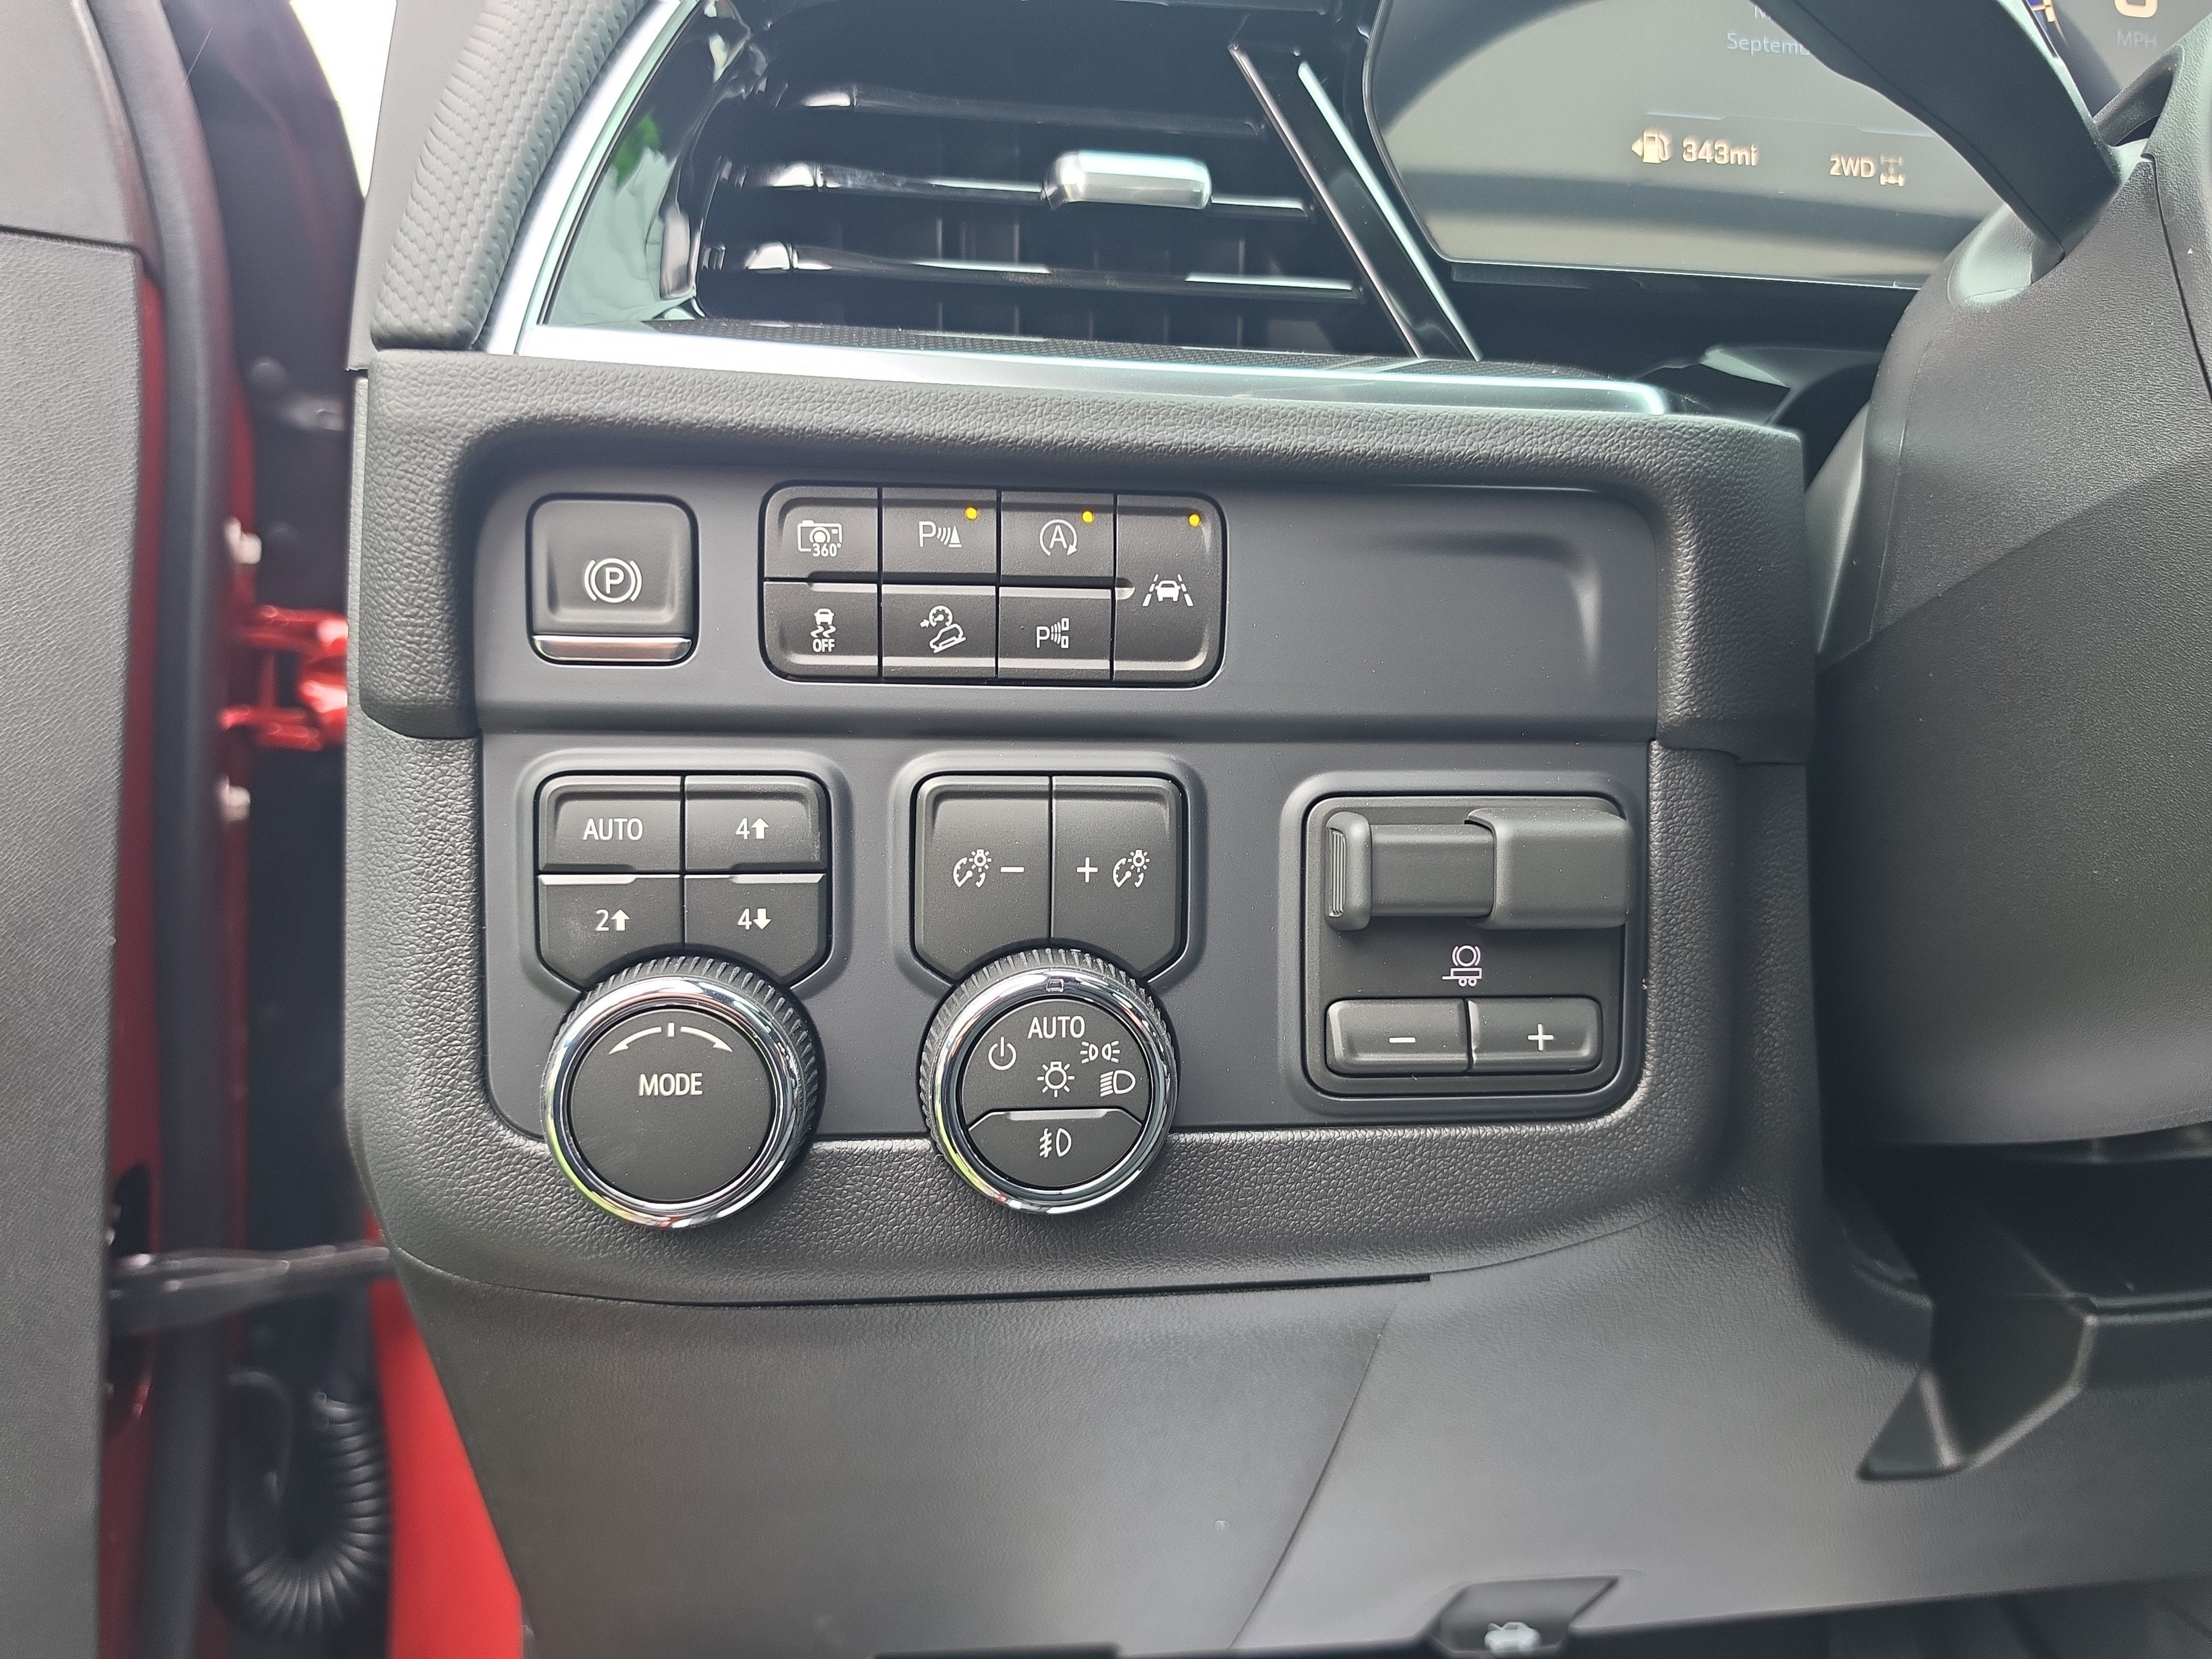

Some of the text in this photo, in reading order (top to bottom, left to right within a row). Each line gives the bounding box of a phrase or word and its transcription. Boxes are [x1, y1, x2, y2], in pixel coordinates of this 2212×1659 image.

[2116, 30, 2157, 50] MPH
[1682, 138, 1758, 166] 343mi
[1829, 156, 1876, 179] 2WD
[918, 520, 934, 546] P
[1049, 525, 1068, 549] A
[605, 567, 625, 594] P
[812, 636, 837, 653] OFF
[1036, 625, 1051, 648] P
[583, 818, 644, 841] AUTO
[735, 818, 750, 840] 4
[595, 909, 611, 932] 2
[737, 909, 753, 931] 4
[1027, 1015, 1086, 1040] AUTO
[639, 1072, 703, 1096] MODE
